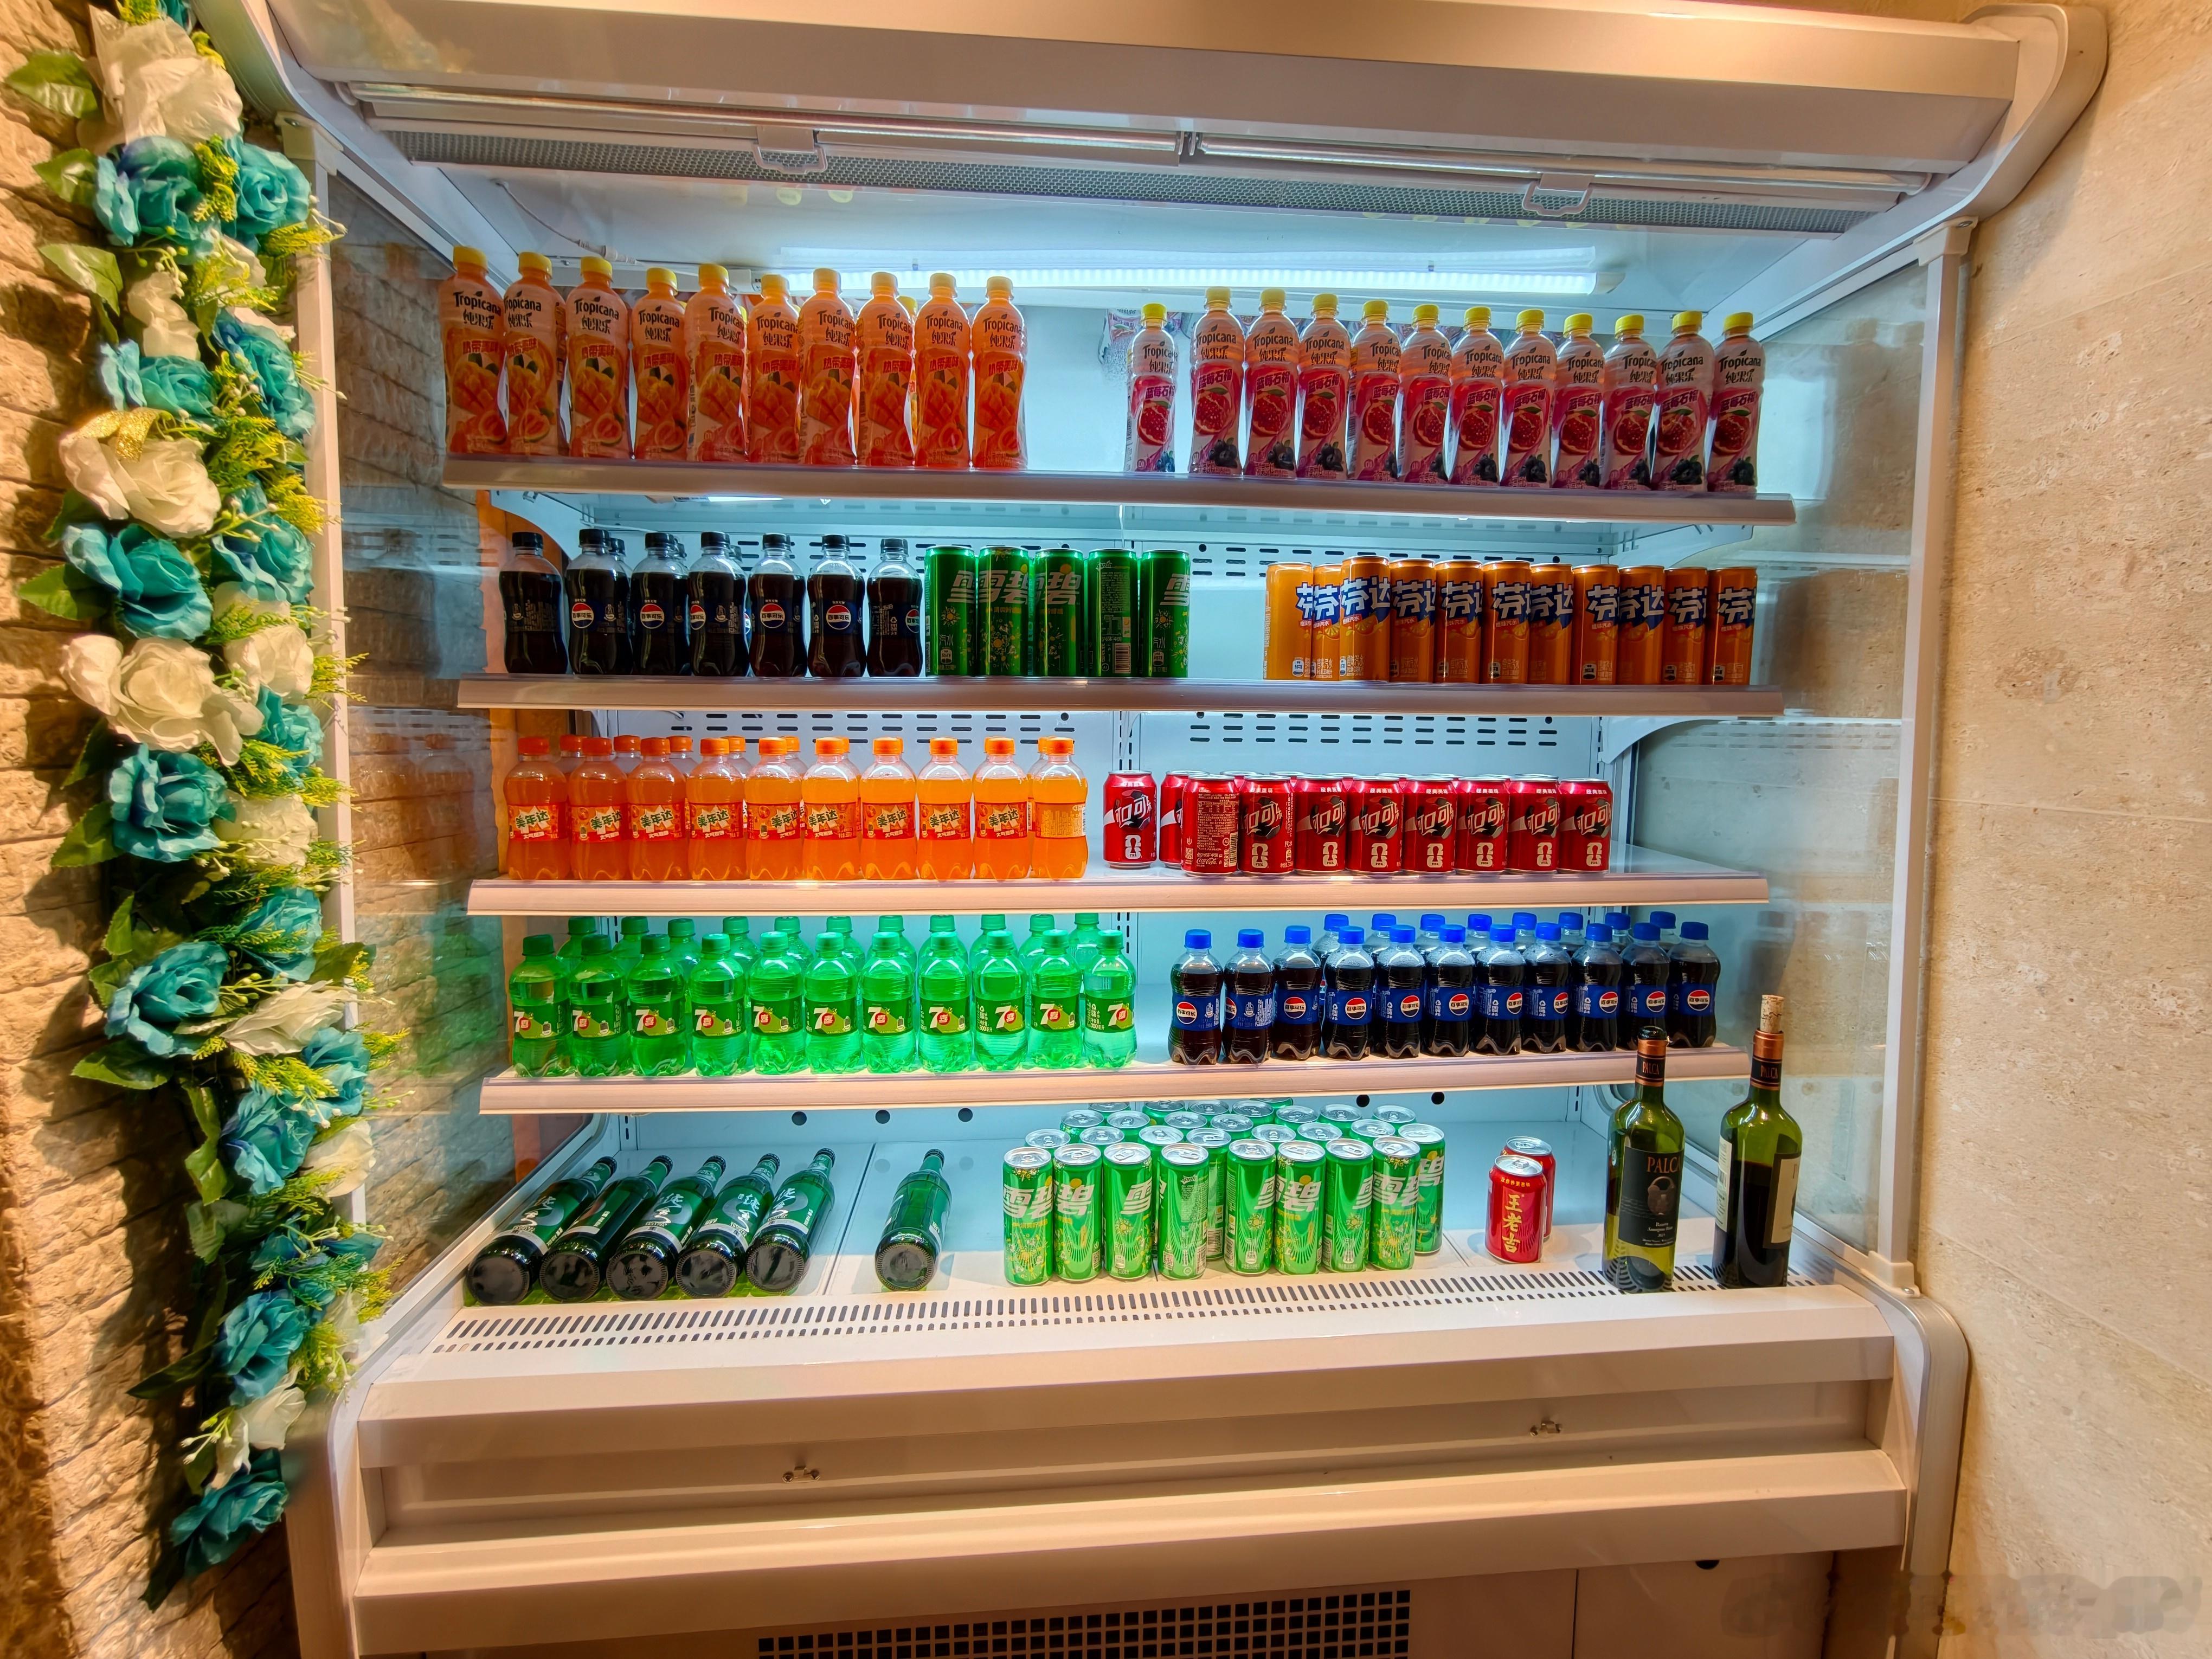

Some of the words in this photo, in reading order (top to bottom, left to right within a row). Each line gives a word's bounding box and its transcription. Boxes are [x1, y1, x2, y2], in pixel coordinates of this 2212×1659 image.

[453, 291, 501, 315] Tropicana
[504, 295, 541, 313] Tropicana
[575, 298, 619, 320] Tropicana
[639, 310, 679, 327] Tropicana
[877, 314, 913, 333] Tropican
[925, 315, 962, 331] Tropicana
[983, 317, 1023, 335] Tropicana
[1196, 331, 1236, 348] Tropicana
[1253, 332, 1293, 350] Tropicana
[1305, 336, 1343, 352] Tropicana
[1142, 344, 1178, 361] Tropicana
[1370, 342, 1400, 358] Tropica
[1422, 344, 1452, 361] Tropica
[1464, 349, 1501, 365] Tropicana
[1511, 353, 1550, 370] Tropicana
[1566, 356, 1603, 371] Tropicana
[1660, 356, 1703, 374] Tropicana
[1718, 356, 1760, 372] Tropicana
[1198, 369, 1232, 389] 蓝莓石榴
[1257, 371, 1290, 390] 蓝莓石榴
[1308, 374, 1340, 394] 蓝莓石榴
[1145, 385, 1175, 399] 蓝莓石榴
[1373, 384, 1399, 399] 蓝莓石
[1467, 388, 1497, 407] 蓝莓石榴
[1514, 389, 1546, 410] 蓝莓石榴
[1662, 389, 1699, 414] 蓝莓石榴
[1720, 391, 1757, 413] 蓝莓石榴
[1341, 576, 1390, 616] 芬达
[516, 811, 549, 828] 美年达
[591, 811, 622, 830] 美年达
[640, 810, 673, 828] 美年达
[698, 810, 729, 828] 美年达
[771, 809, 798, 828] 美年达
[808, 809, 838, 827] 美年达
[877, 809, 907, 827] 美年达
[929, 809, 960, 827] 美年达
[989, 809, 1019, 827] 美年达
[1177, 1007, 1196, 1017] 百事可乐
[1643, 1060, 1659, 1075] PALCA
[1760, 1065, 1778, 1078] PALCA
[1502, 1194, 1522, 1253] 王老吉
